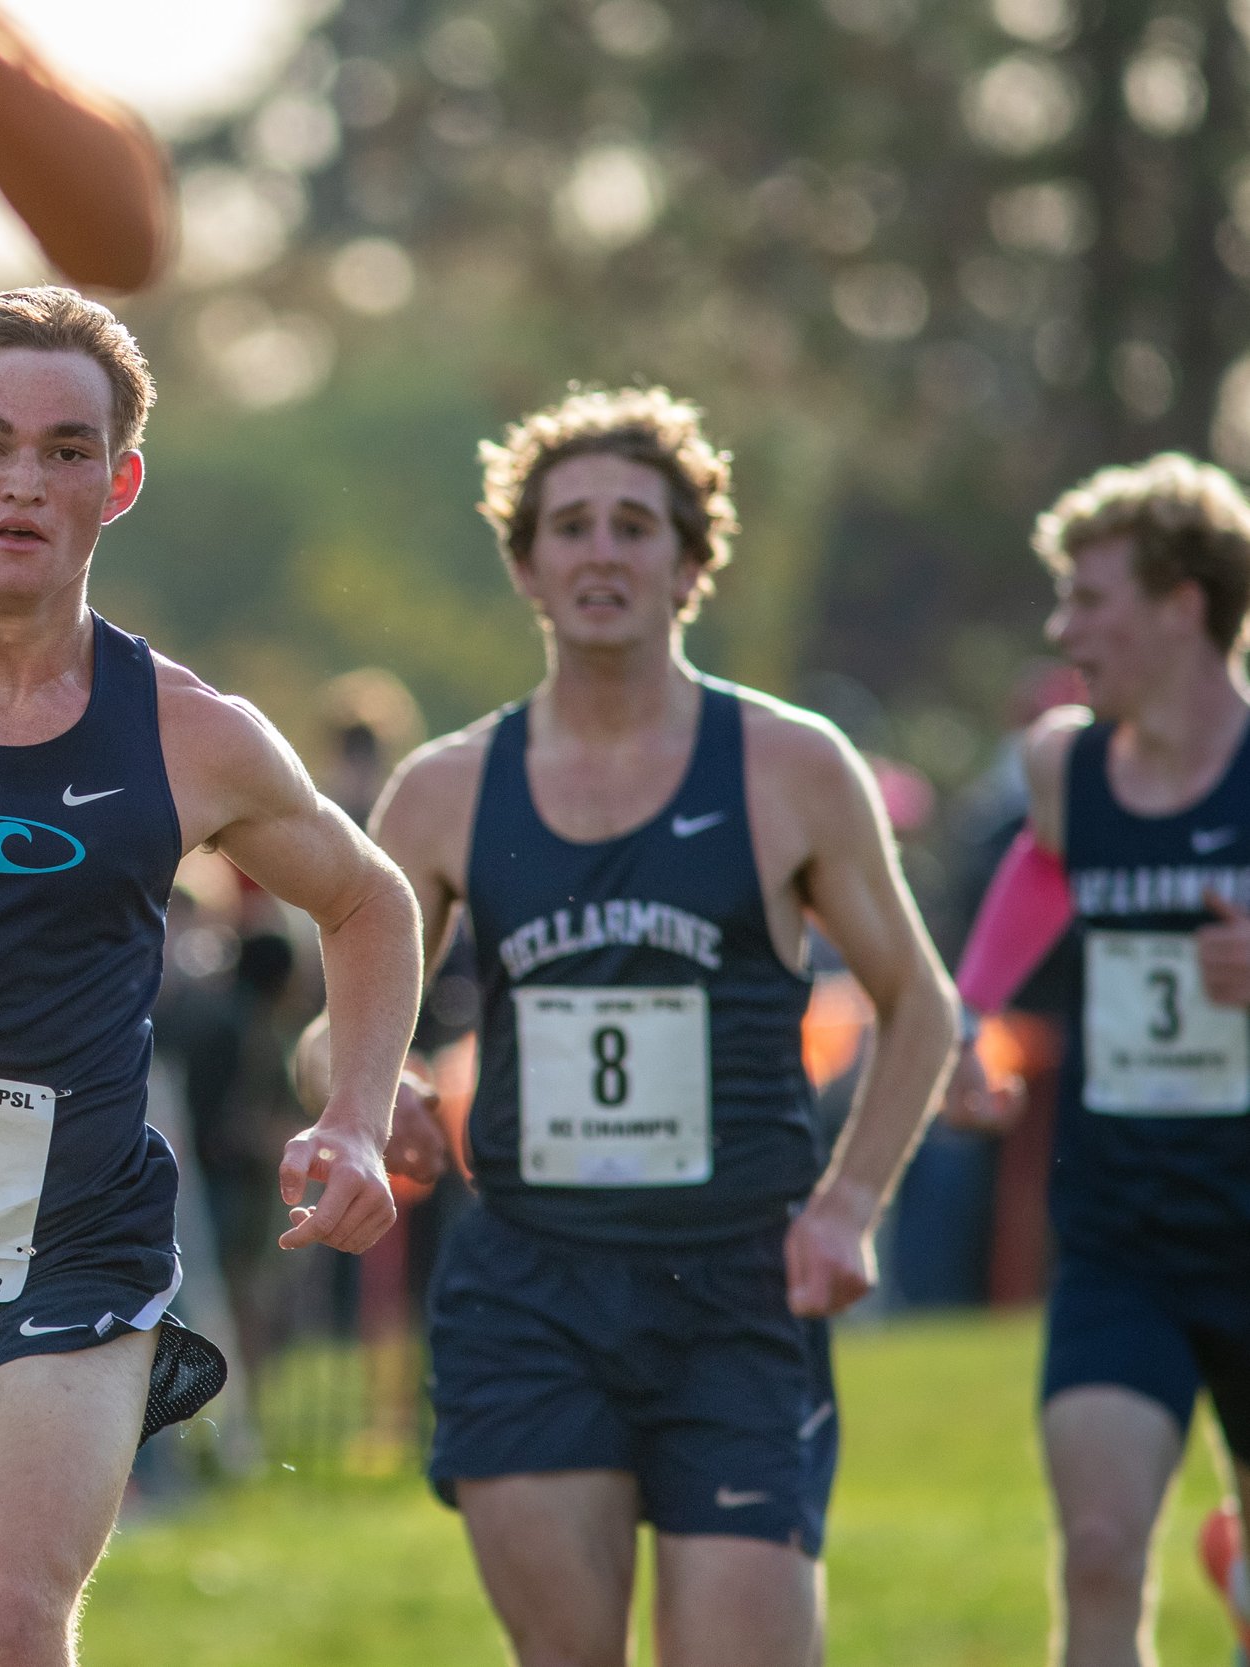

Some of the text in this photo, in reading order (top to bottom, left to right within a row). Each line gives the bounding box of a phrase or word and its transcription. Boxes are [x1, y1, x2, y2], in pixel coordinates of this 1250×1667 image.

[500, 899, 723, 981] BELLARMINE
[1147, 967, 1181, 1043] 3
[591, 1023, 628, 1108] 8
[581, 1119, 679, 1138] CHAMPS
